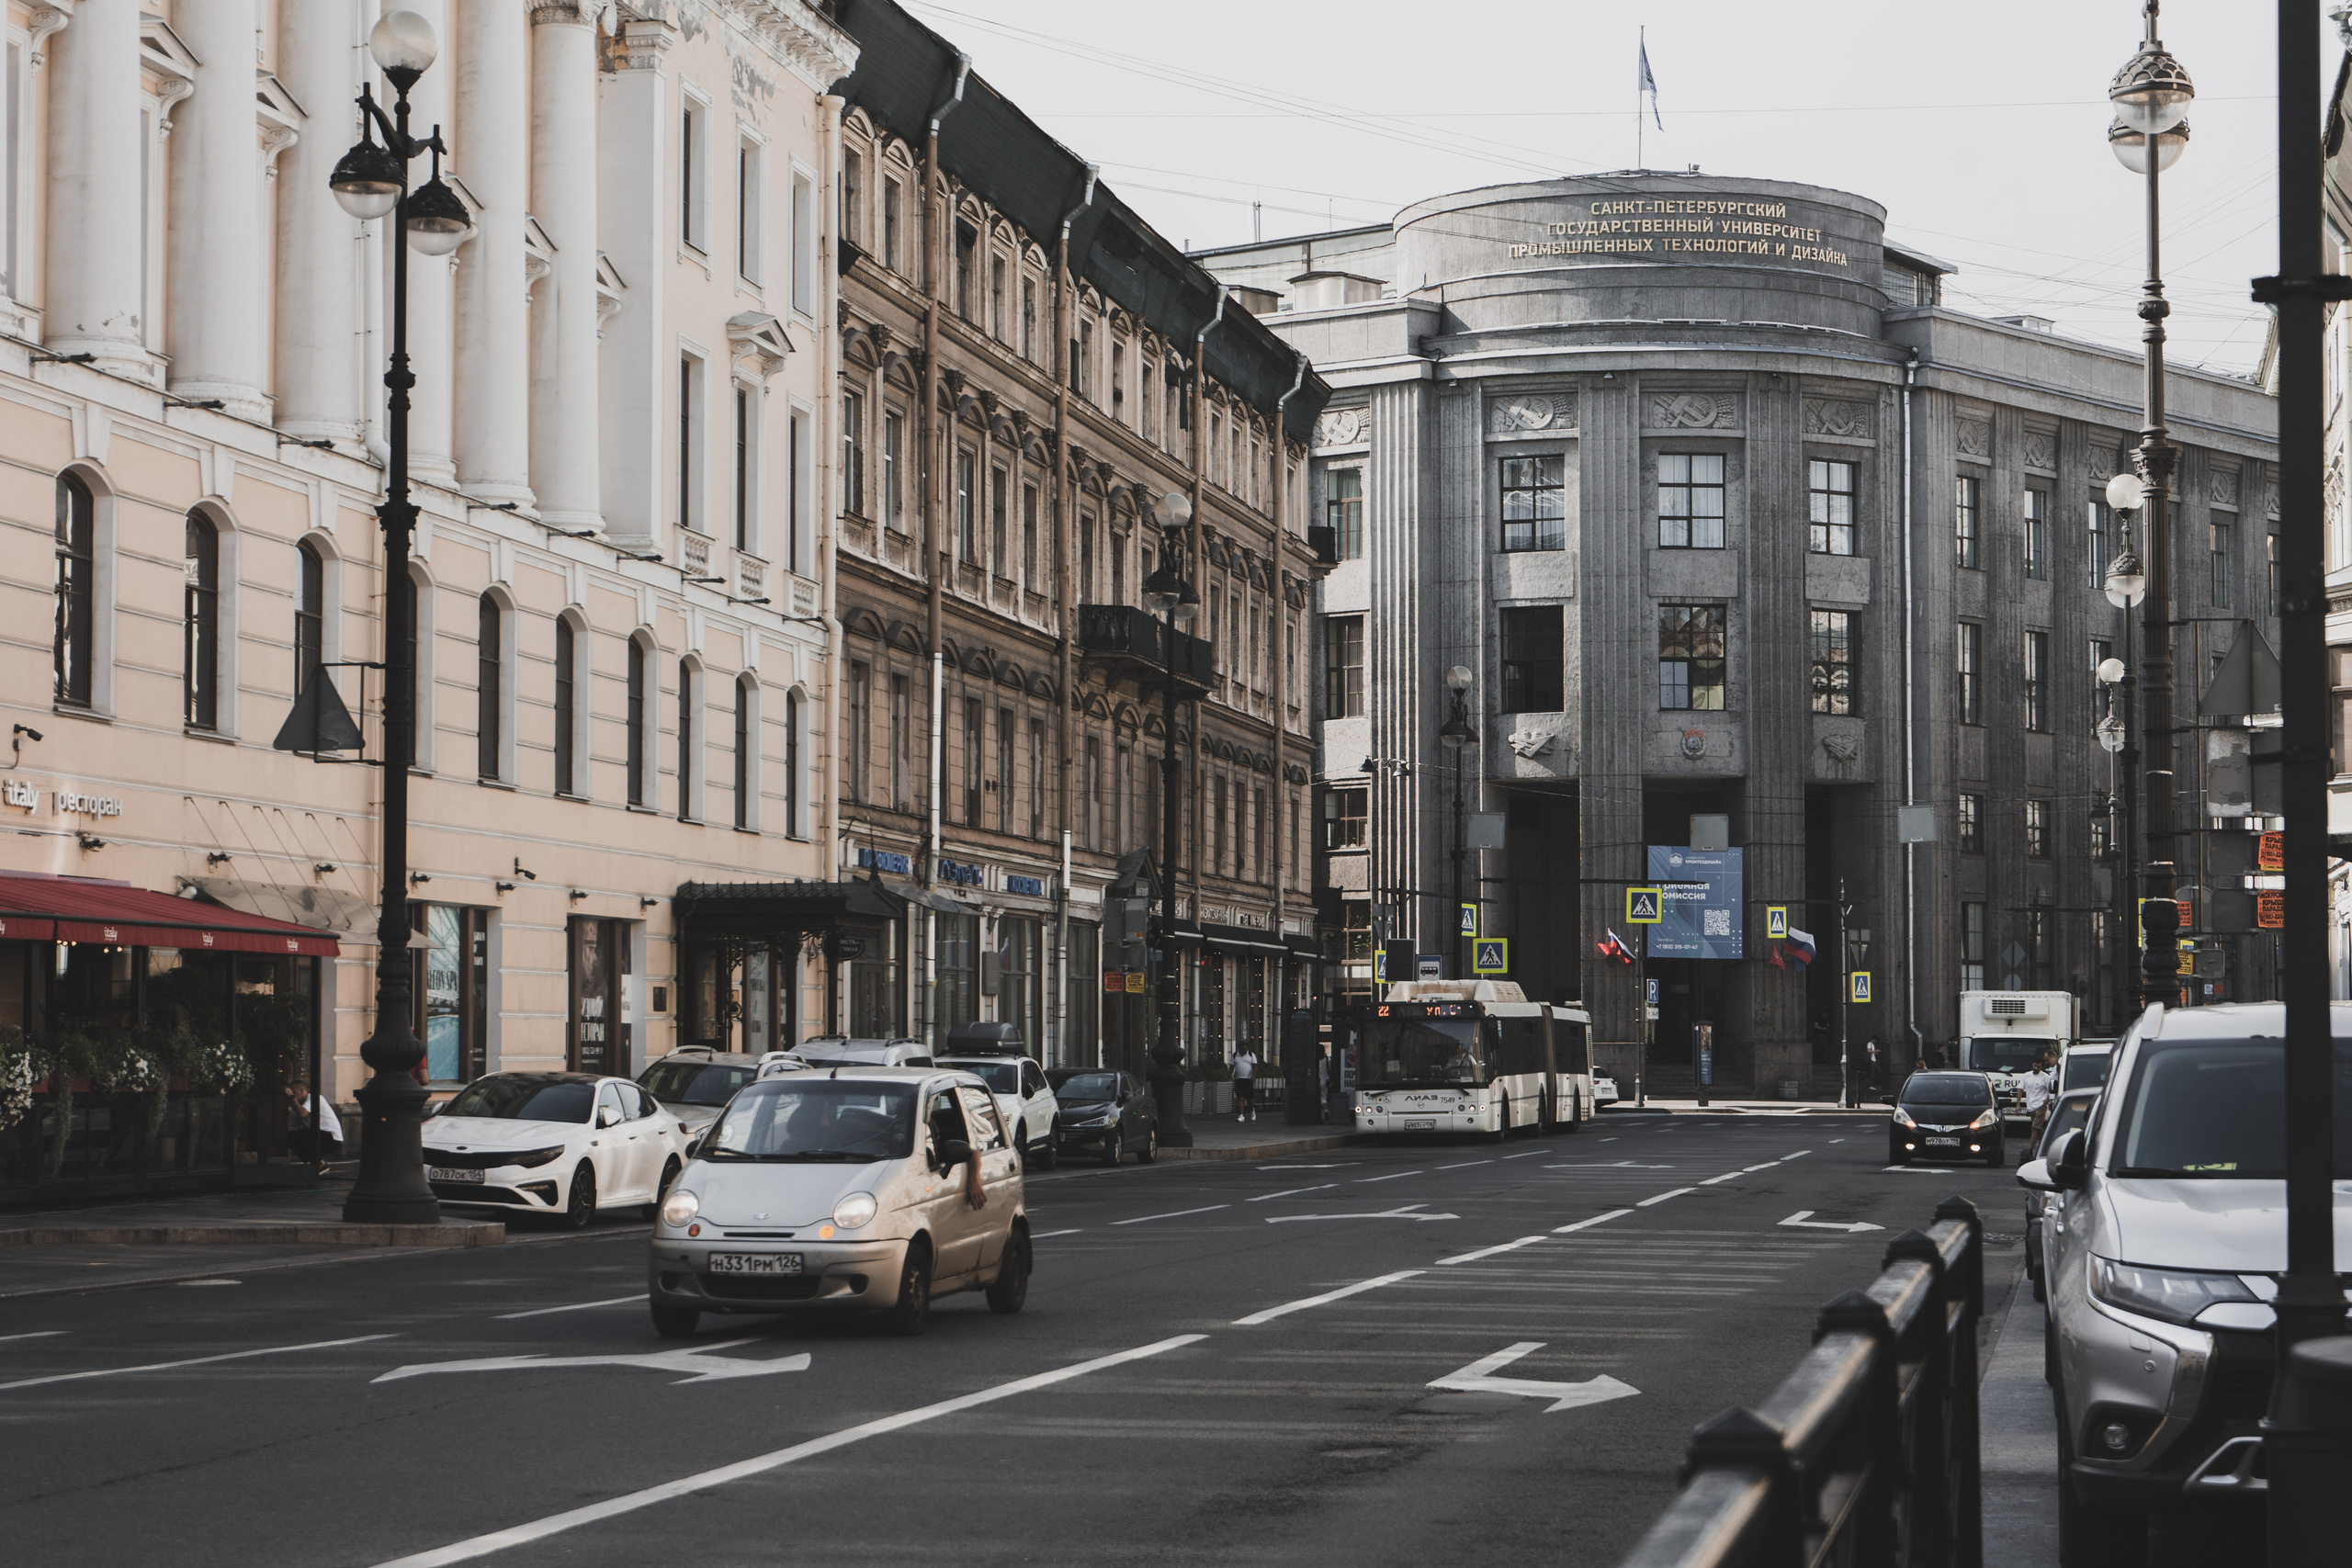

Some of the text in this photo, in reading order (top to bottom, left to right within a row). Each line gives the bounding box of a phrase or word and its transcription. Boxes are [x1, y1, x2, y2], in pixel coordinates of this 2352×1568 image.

[1590, 200, 1787, 219] САНКТ-ПЕТЕРБУРГСКИЙ
[1546, 217, 1821, 243] ГОСУДАРСТВЕННЫЙ УНИВЕРСИТЕТ
[1508, 236, 1848, 267] ПРОМЫШЛЕННЫХ ТЕХНОЛОГИЙ И ДИЗАЙНА
[4, 779, 40, 815] italy
[58, 791, 123, 820] ресторан
[863, 850, 910, 874] ПФЮМЕРИЯ
[1661, 892, 1706, 900] омиссия
[1378, 1006, 1389, 1017] 22
[716, 1256, 798, 1271] Н331РМ 126
